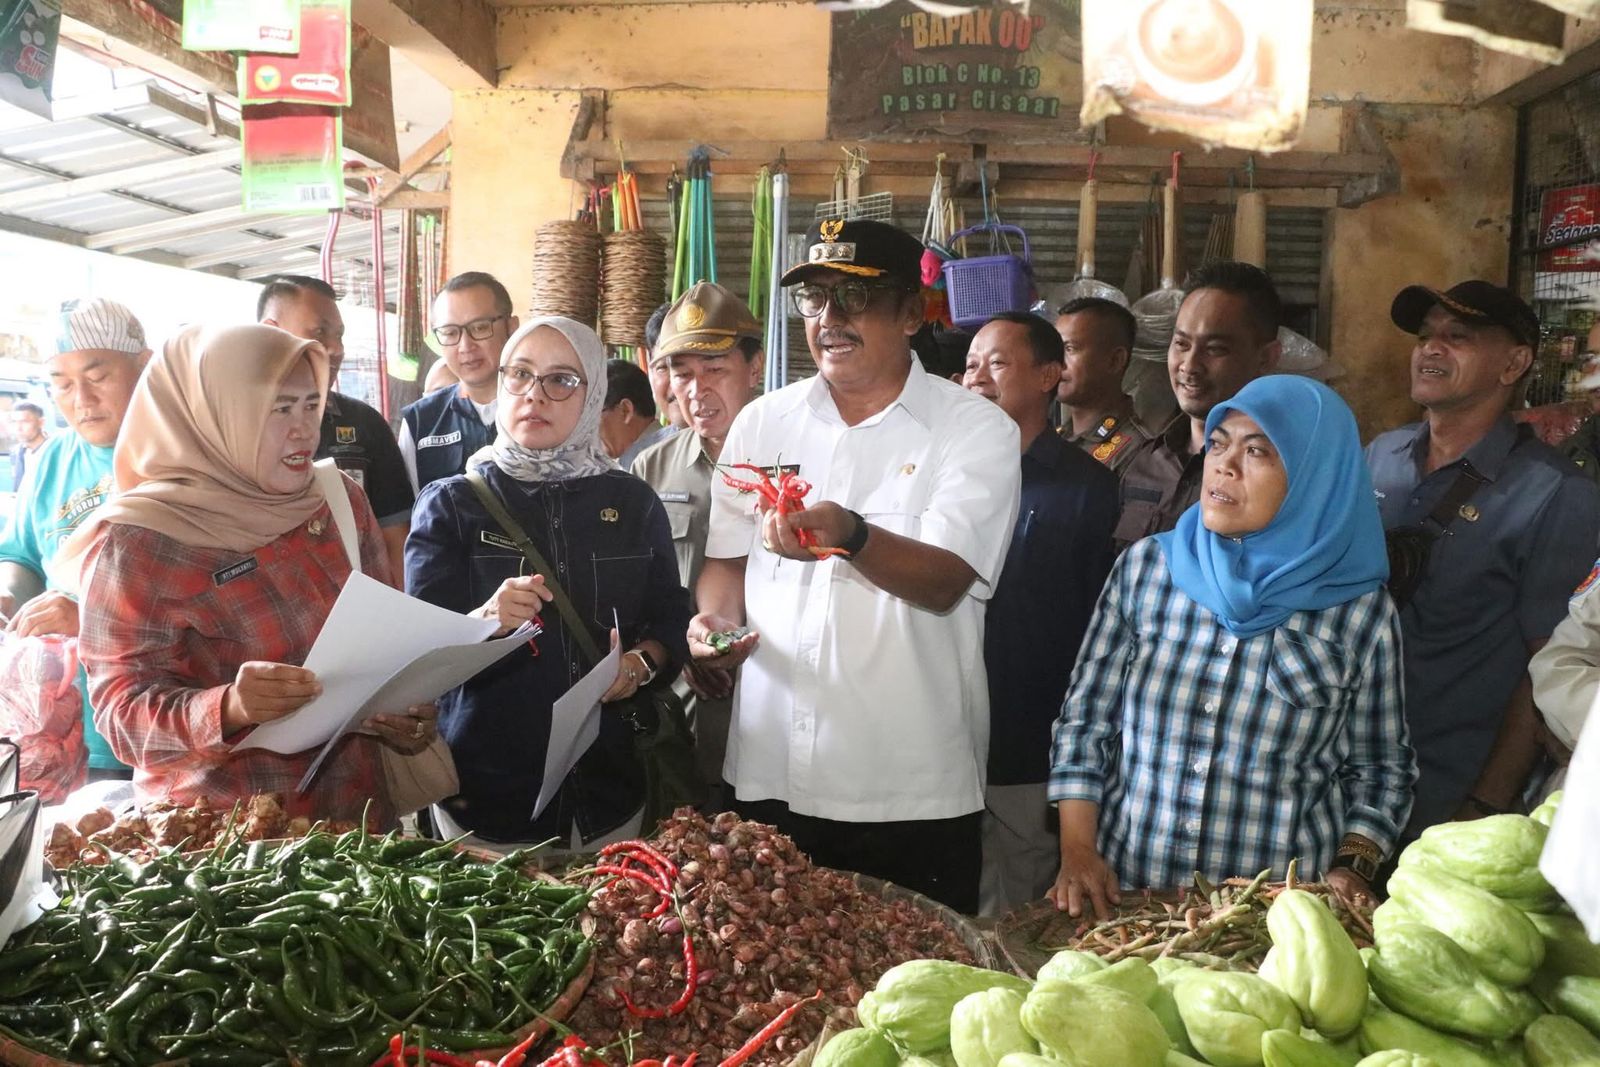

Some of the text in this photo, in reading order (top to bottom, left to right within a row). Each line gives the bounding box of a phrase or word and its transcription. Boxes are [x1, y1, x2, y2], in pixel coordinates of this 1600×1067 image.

[903, 63, 1041, 87] Blok C No. 13
[883, 90, 1060, 117] Pasar Cisaat
